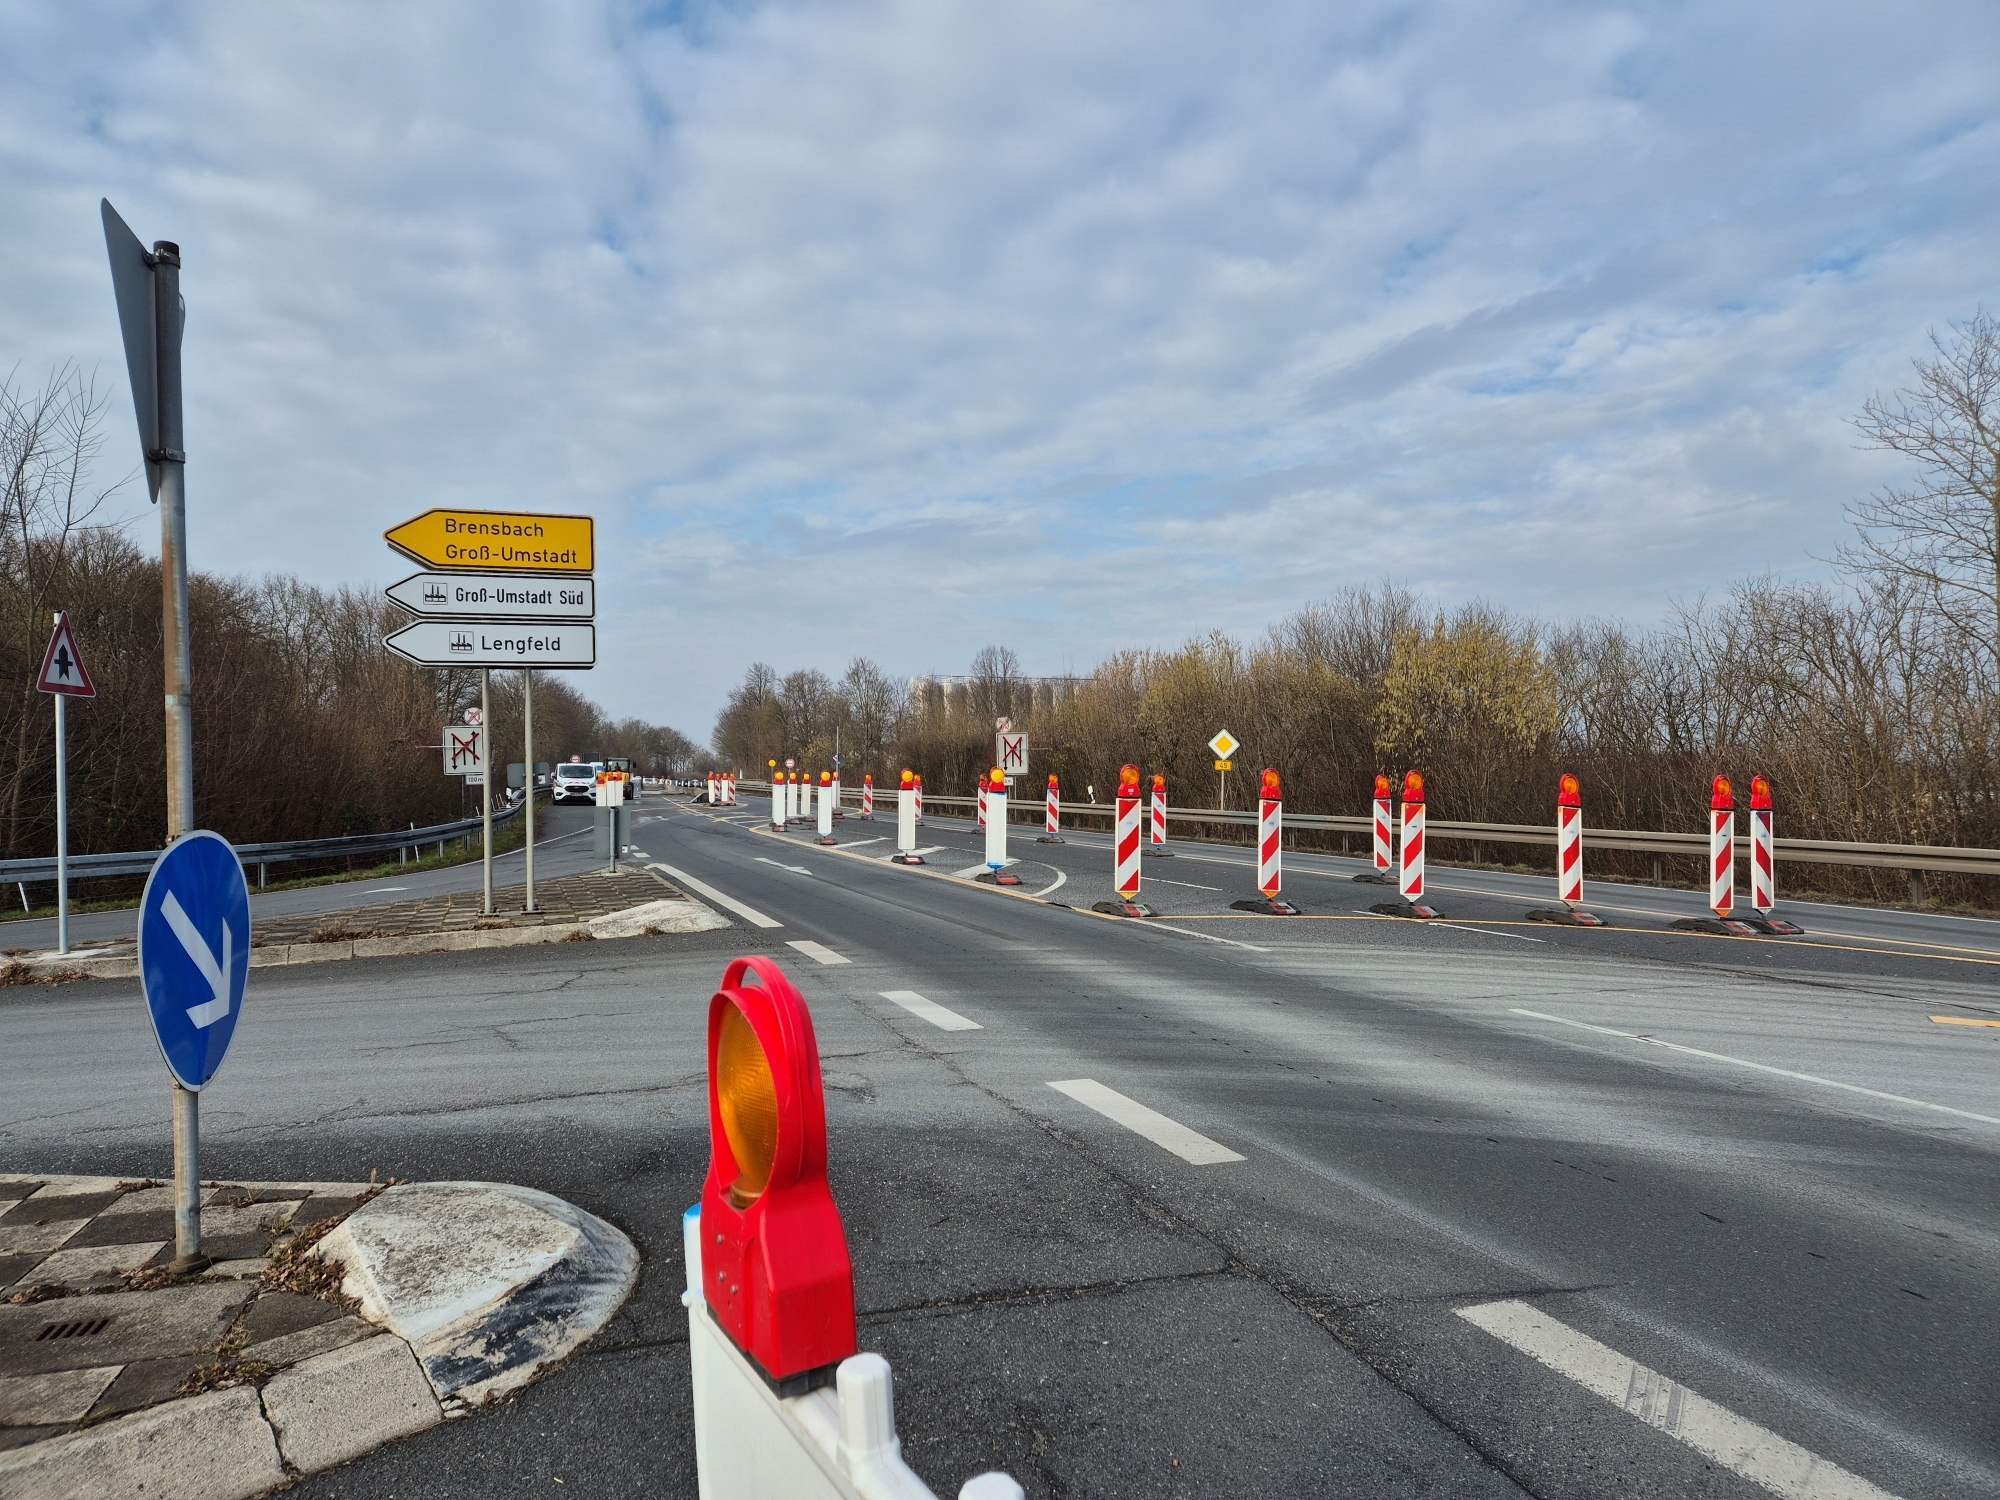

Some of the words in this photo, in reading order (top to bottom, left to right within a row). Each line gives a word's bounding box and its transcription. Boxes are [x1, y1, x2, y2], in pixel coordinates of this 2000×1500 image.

[445, 518, 544, 537] Brensbach
[445, 544, 577, 564] Groß-Umstadt
[455, 587, 552, 605] Groß-Umstadt
[559, 590, 584, 605] Süd
[481, 635, 561, 654] Lengfeld
